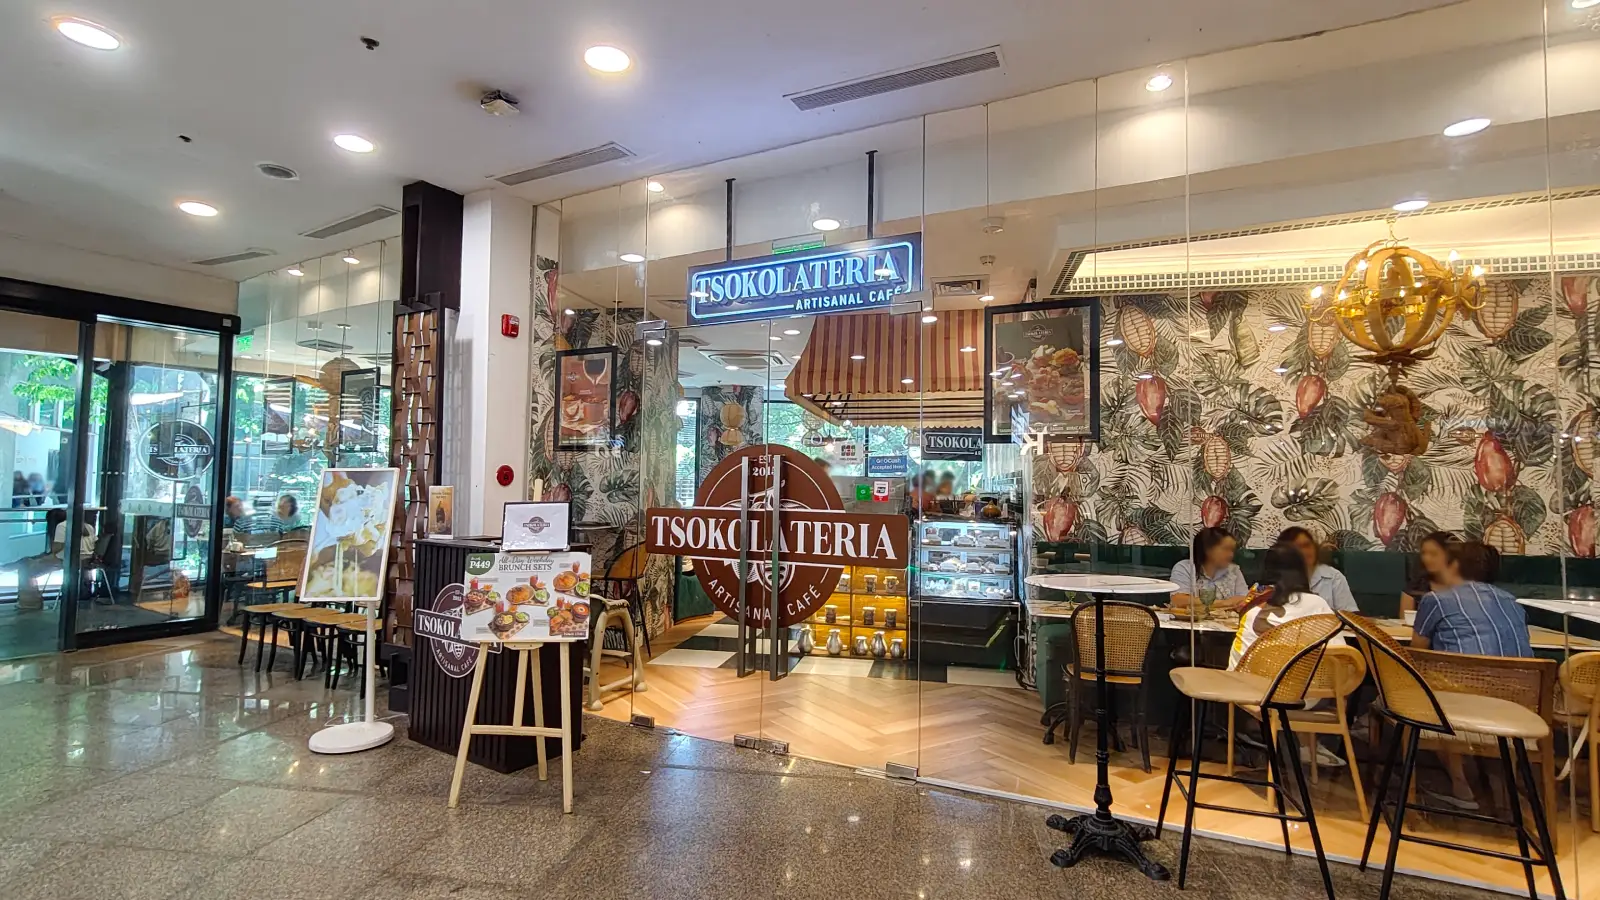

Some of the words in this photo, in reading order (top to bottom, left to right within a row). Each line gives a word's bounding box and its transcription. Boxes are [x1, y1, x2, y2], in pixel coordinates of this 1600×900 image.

[696, 251, 900, 304] TSOKOLATERIA
[795, 293, 863, 311] ARTISANAL
[869, 285, 902, 303] CAFÉ
[651, 516, 897, 560] TSOKOLATERIA
[498, 563, 532, 571] BRUNCH
[708, 578, 781, 621] ARTISANA
[787, 584, 821, 616] CAFÉ
[436, 648, 460, 672] ARTISANAL
